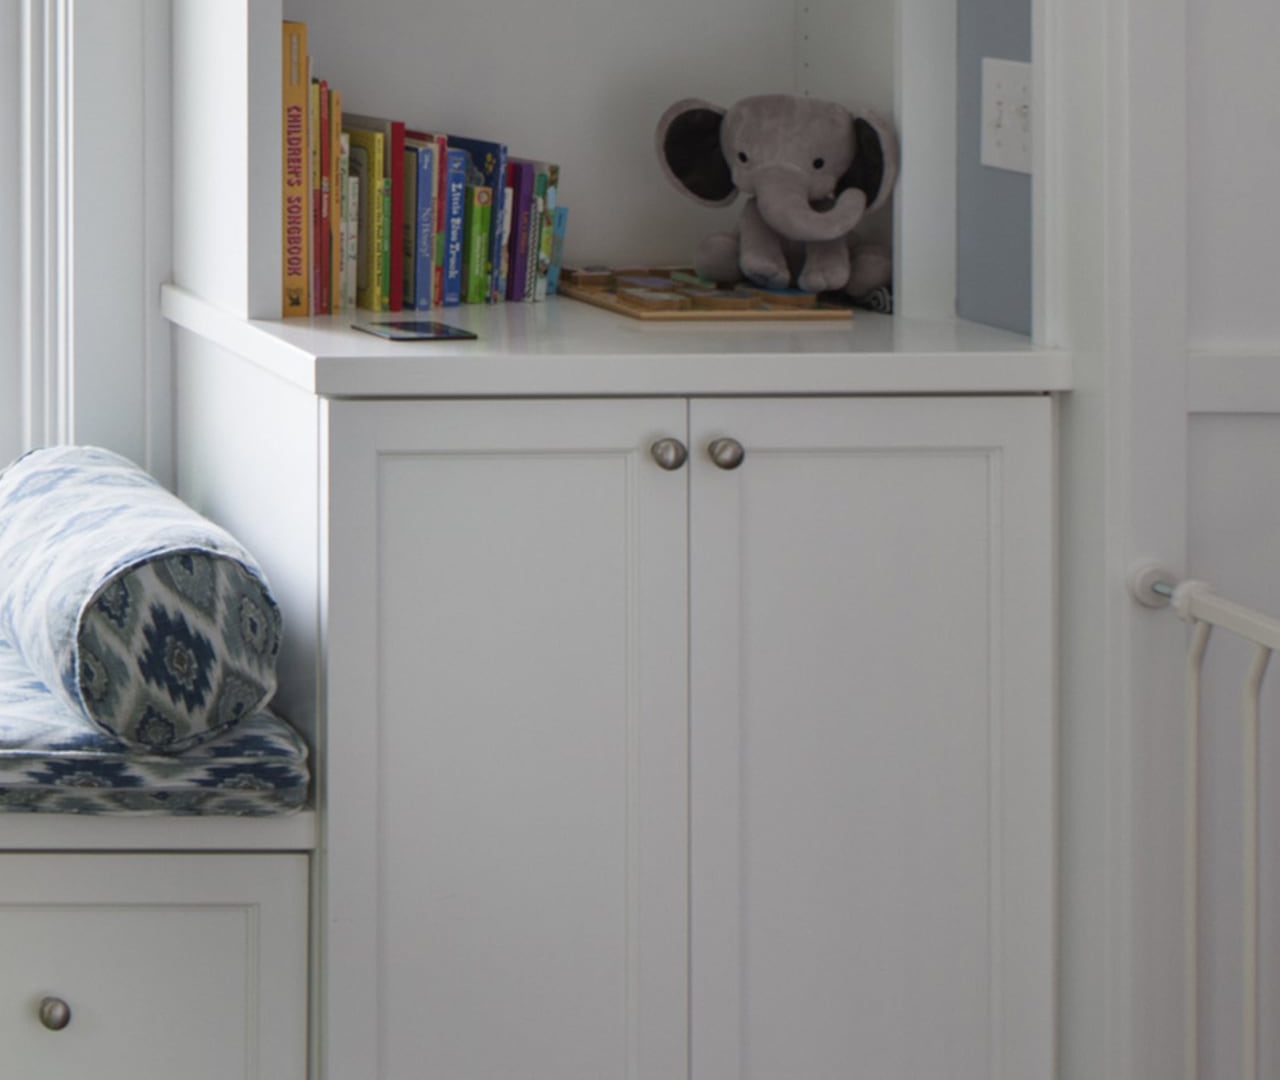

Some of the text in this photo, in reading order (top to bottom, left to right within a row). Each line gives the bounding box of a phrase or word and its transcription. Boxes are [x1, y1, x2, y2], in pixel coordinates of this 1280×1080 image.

[286, 104, 303, 277] CHILDREN'S SONGBOOK
[447, 181, 463, 280] Little Blue Truck
